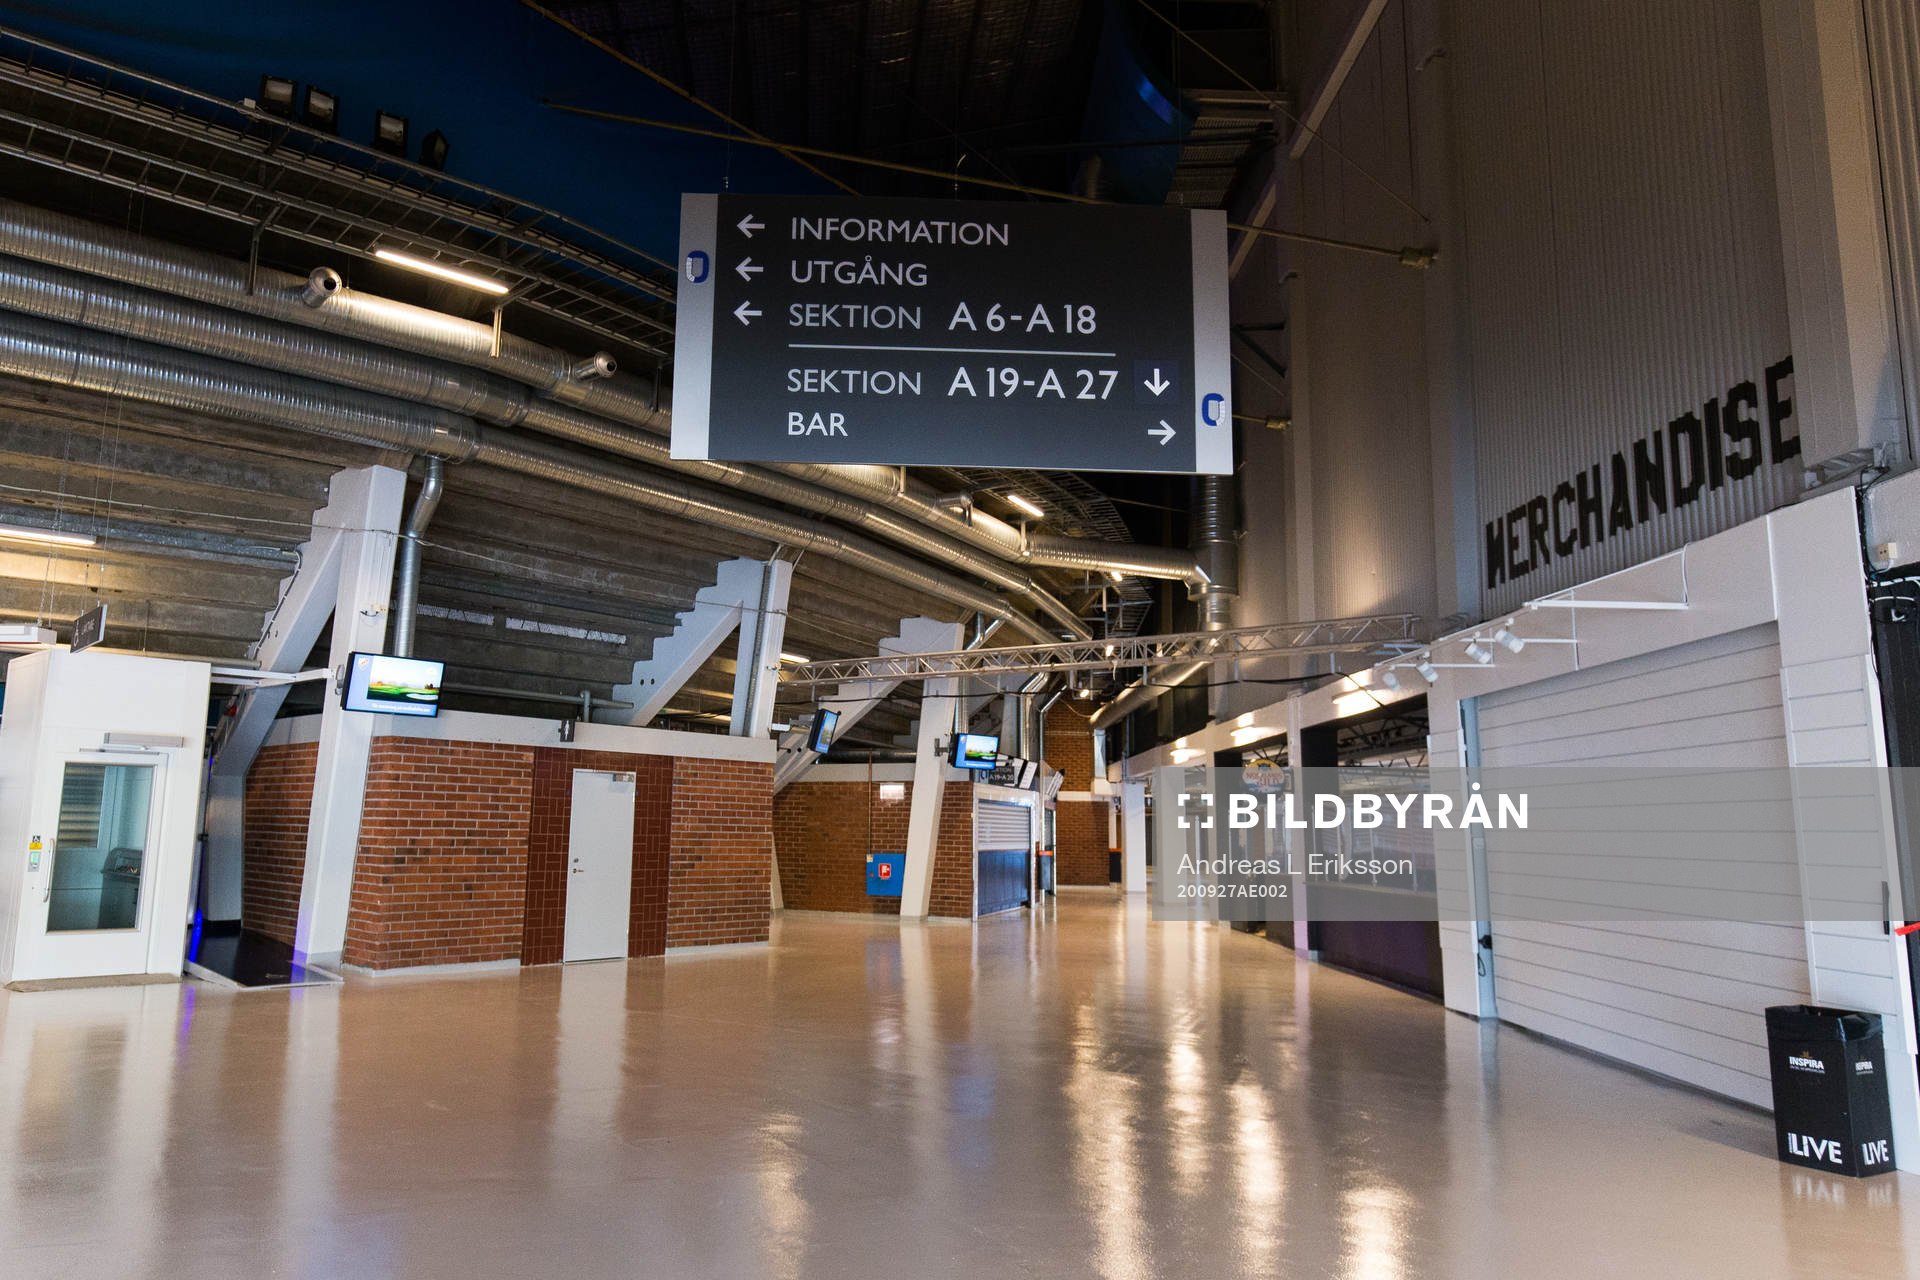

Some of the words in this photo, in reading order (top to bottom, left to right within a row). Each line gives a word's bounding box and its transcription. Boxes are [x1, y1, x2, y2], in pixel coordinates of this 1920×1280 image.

[791, 216, 1009, 246] INFORMATION
[791, 254, 928, 287] UTGÅNG
[789, 303, 921, 329] SEKTION
[948, 302, 977, 331] A
[1063, 304, 1097, 334] 18
[787, 368, 921, 395] SEKTION
[947, 366, 977, 397] A
[1076, 369, 1119, 400] 27
[788, 411, 848, 436] BAR
[1486, 355, 1801, 590] MERCHANDISE
[1789, 1056, 1825, 1070] INSPIRA
